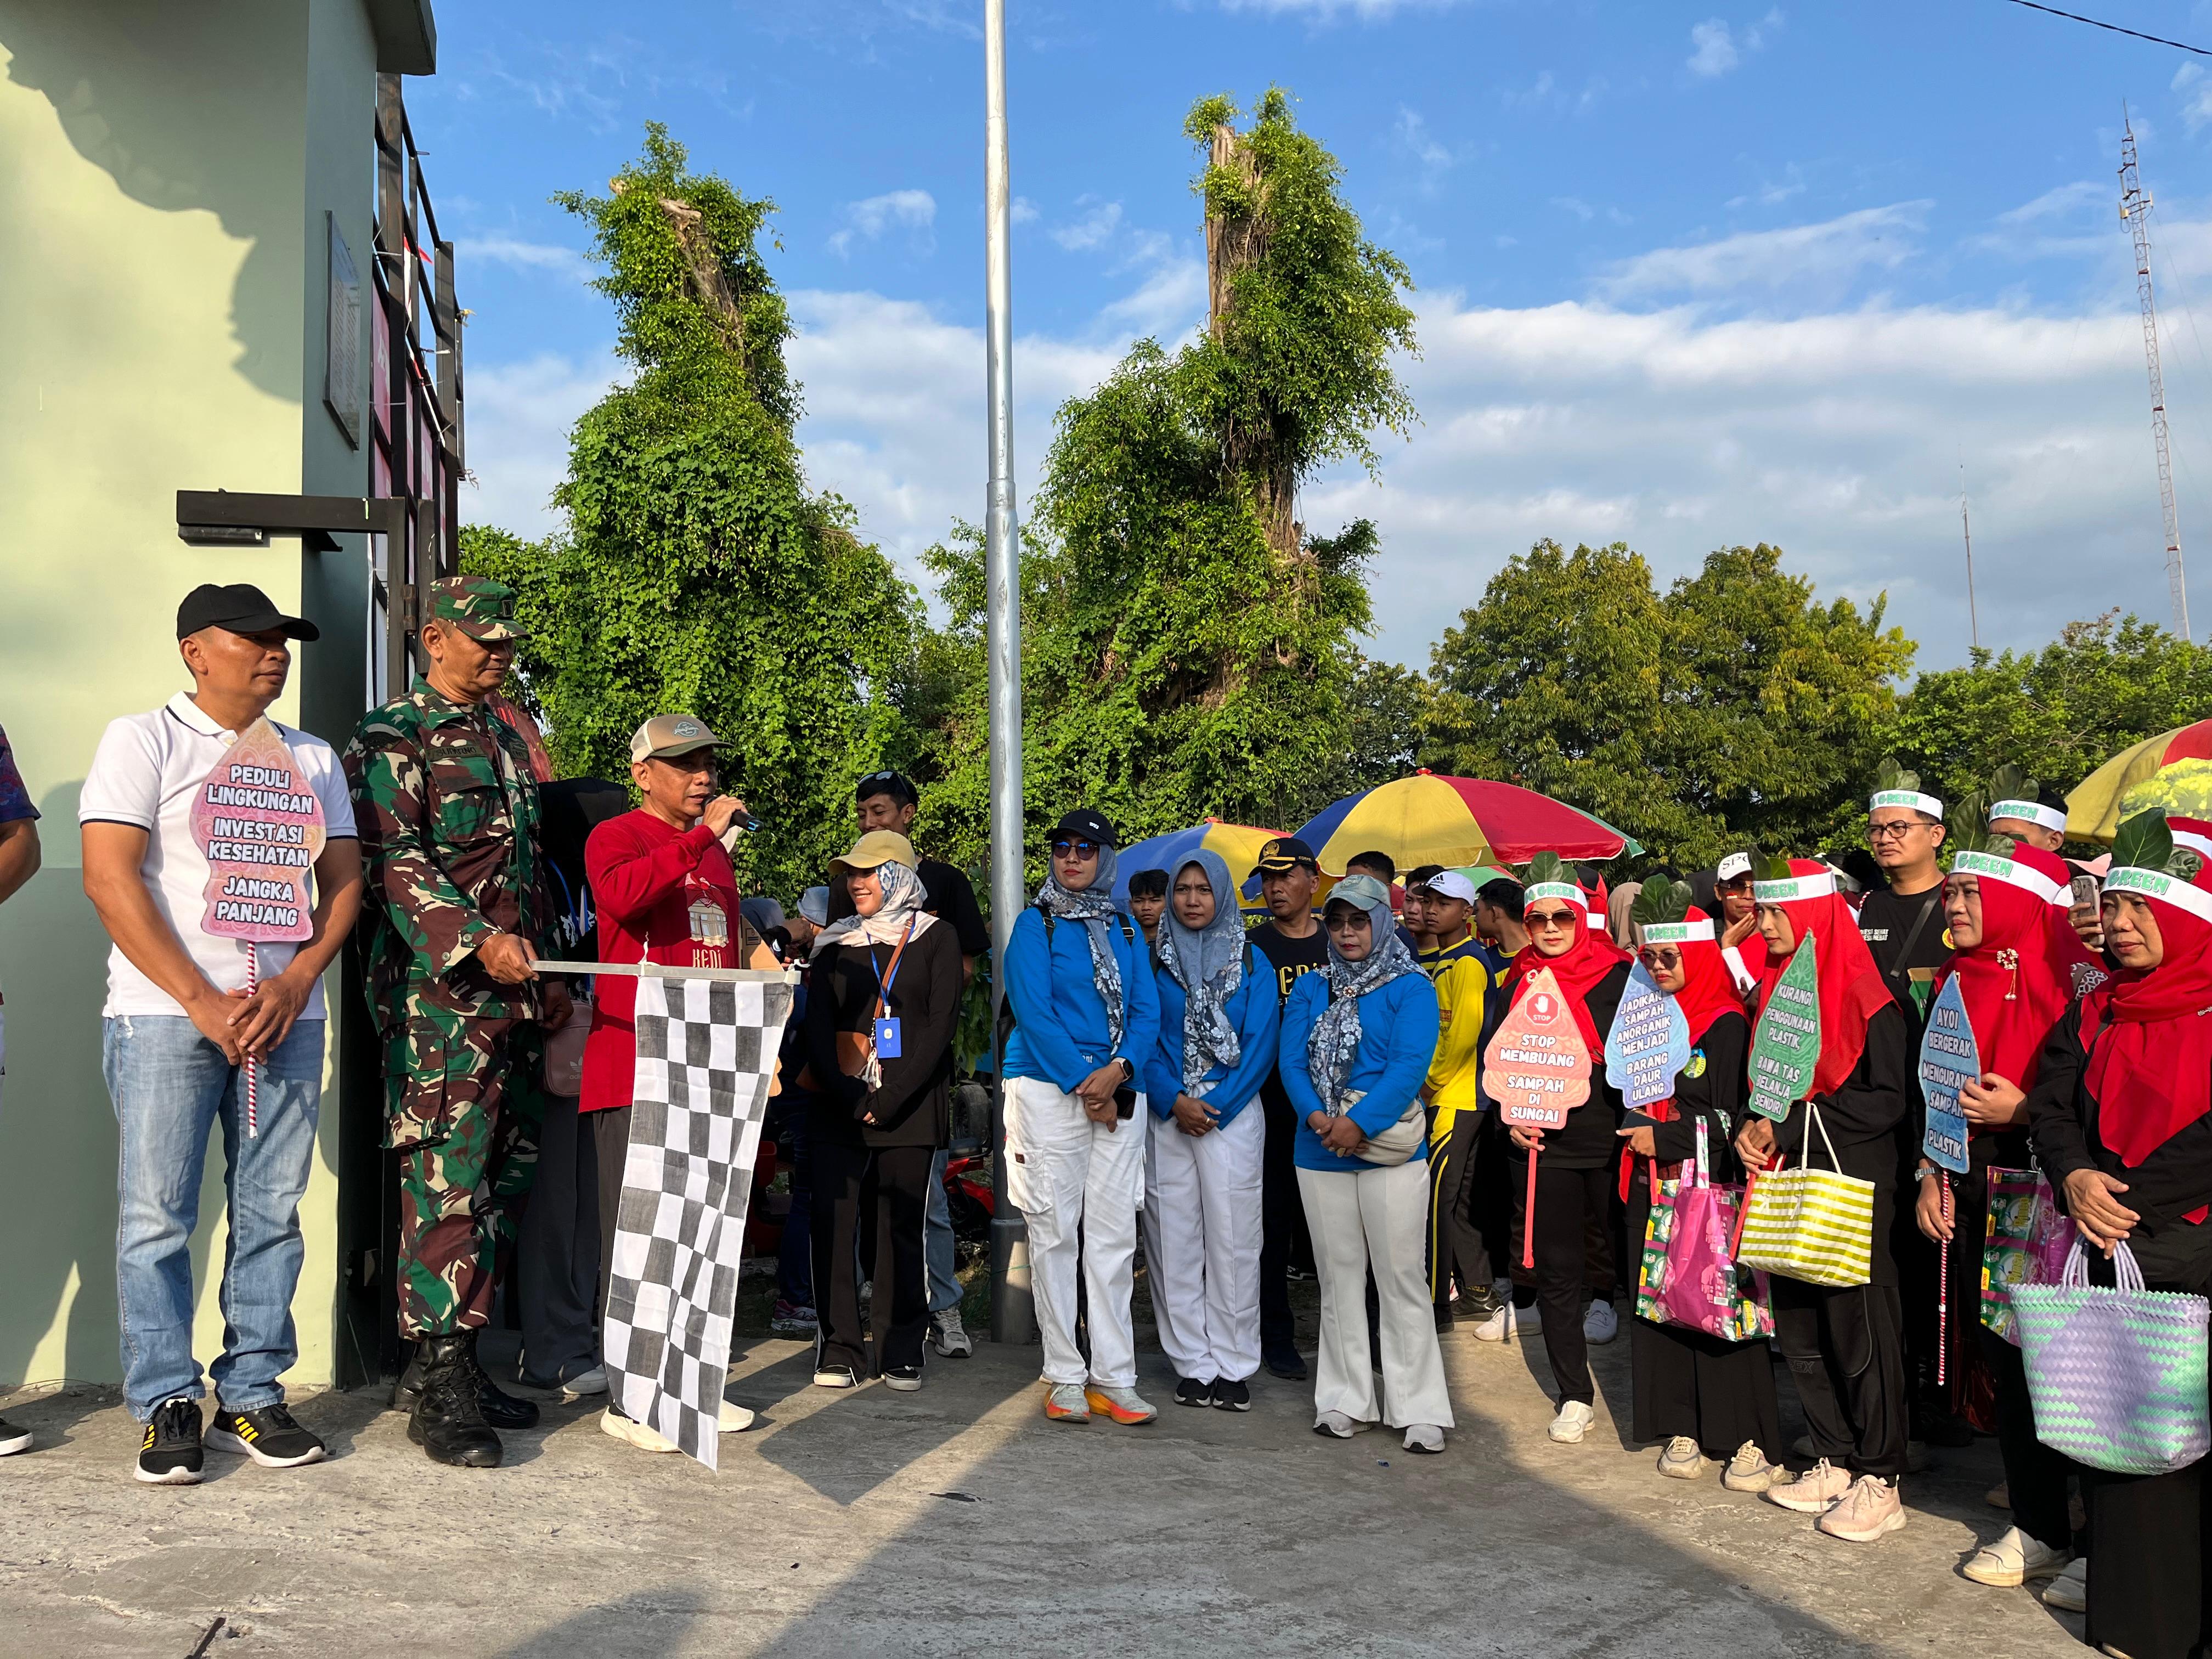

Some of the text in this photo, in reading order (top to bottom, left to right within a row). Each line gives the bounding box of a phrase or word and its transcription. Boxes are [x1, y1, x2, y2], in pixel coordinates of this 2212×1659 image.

[435, 747, 476, 756] SUPARNO
[230, 764, 290, 789] PEDULI
[206, 783, 314, 814] LINGKUNGAN
[1878, 793, 1918, 806] GREEN
[1995, 804, 2039, 820] GREEN
[213, 817, 304, 844] INVESTASI
[208, 840, 309, 867] KESEHATAN
[1957, 853, 2014, 878] GREEN
[223, 876, 295, 902] JANGKA
[1537, 884, 1576, 899] GREEN
[1756, 882, 1799, 899] GREEN
[2108, 870, 2171, 895] GREEN
[216, 900, 300, 927] PANJANG
[1646, 926, 1688, 941] GREEN
[1620, 990, 1662, 1015] JADIKAN
[1777, 983, 1814, 1006] KURANGI
[1624, 1002, 1664, 1027] SAMPAH
[1765, 1006, 1816, 1035] PENGGUNAAN
[1521, 1034, 1556, 1048] STOP
[1616, 1015, 1672, 1045] ANORGANIK
[1767, 1026, 1801, 1052] PLASTIK,
[1622, 1030, 1669, 1058] MENJADI
[1928, 1031, 1972, 1059] BERGERAK
[1499, 1047, 1576, 1068] MEMBUANG
[1626, 1051, 1668, 1075] BARANG
[1757, 1055, 1801, 1084] BAWA TAS
[1506, 1075, 1565, 1093] SAMPAH
[1634, 1069, 1662, 1087] DAUR
[1756, 1074, 1791, 1101] BELANJA
[1528, 1093, 1541, 1105] DI
[1632, 1082, 1664, 1102] ULANG
[1754, 1092, 1785, 1116] SENDIRI
[1509, 1106, 1560, 1123] SUNGAI
[1927, 1128, 1962, 1161] PLASTIK
